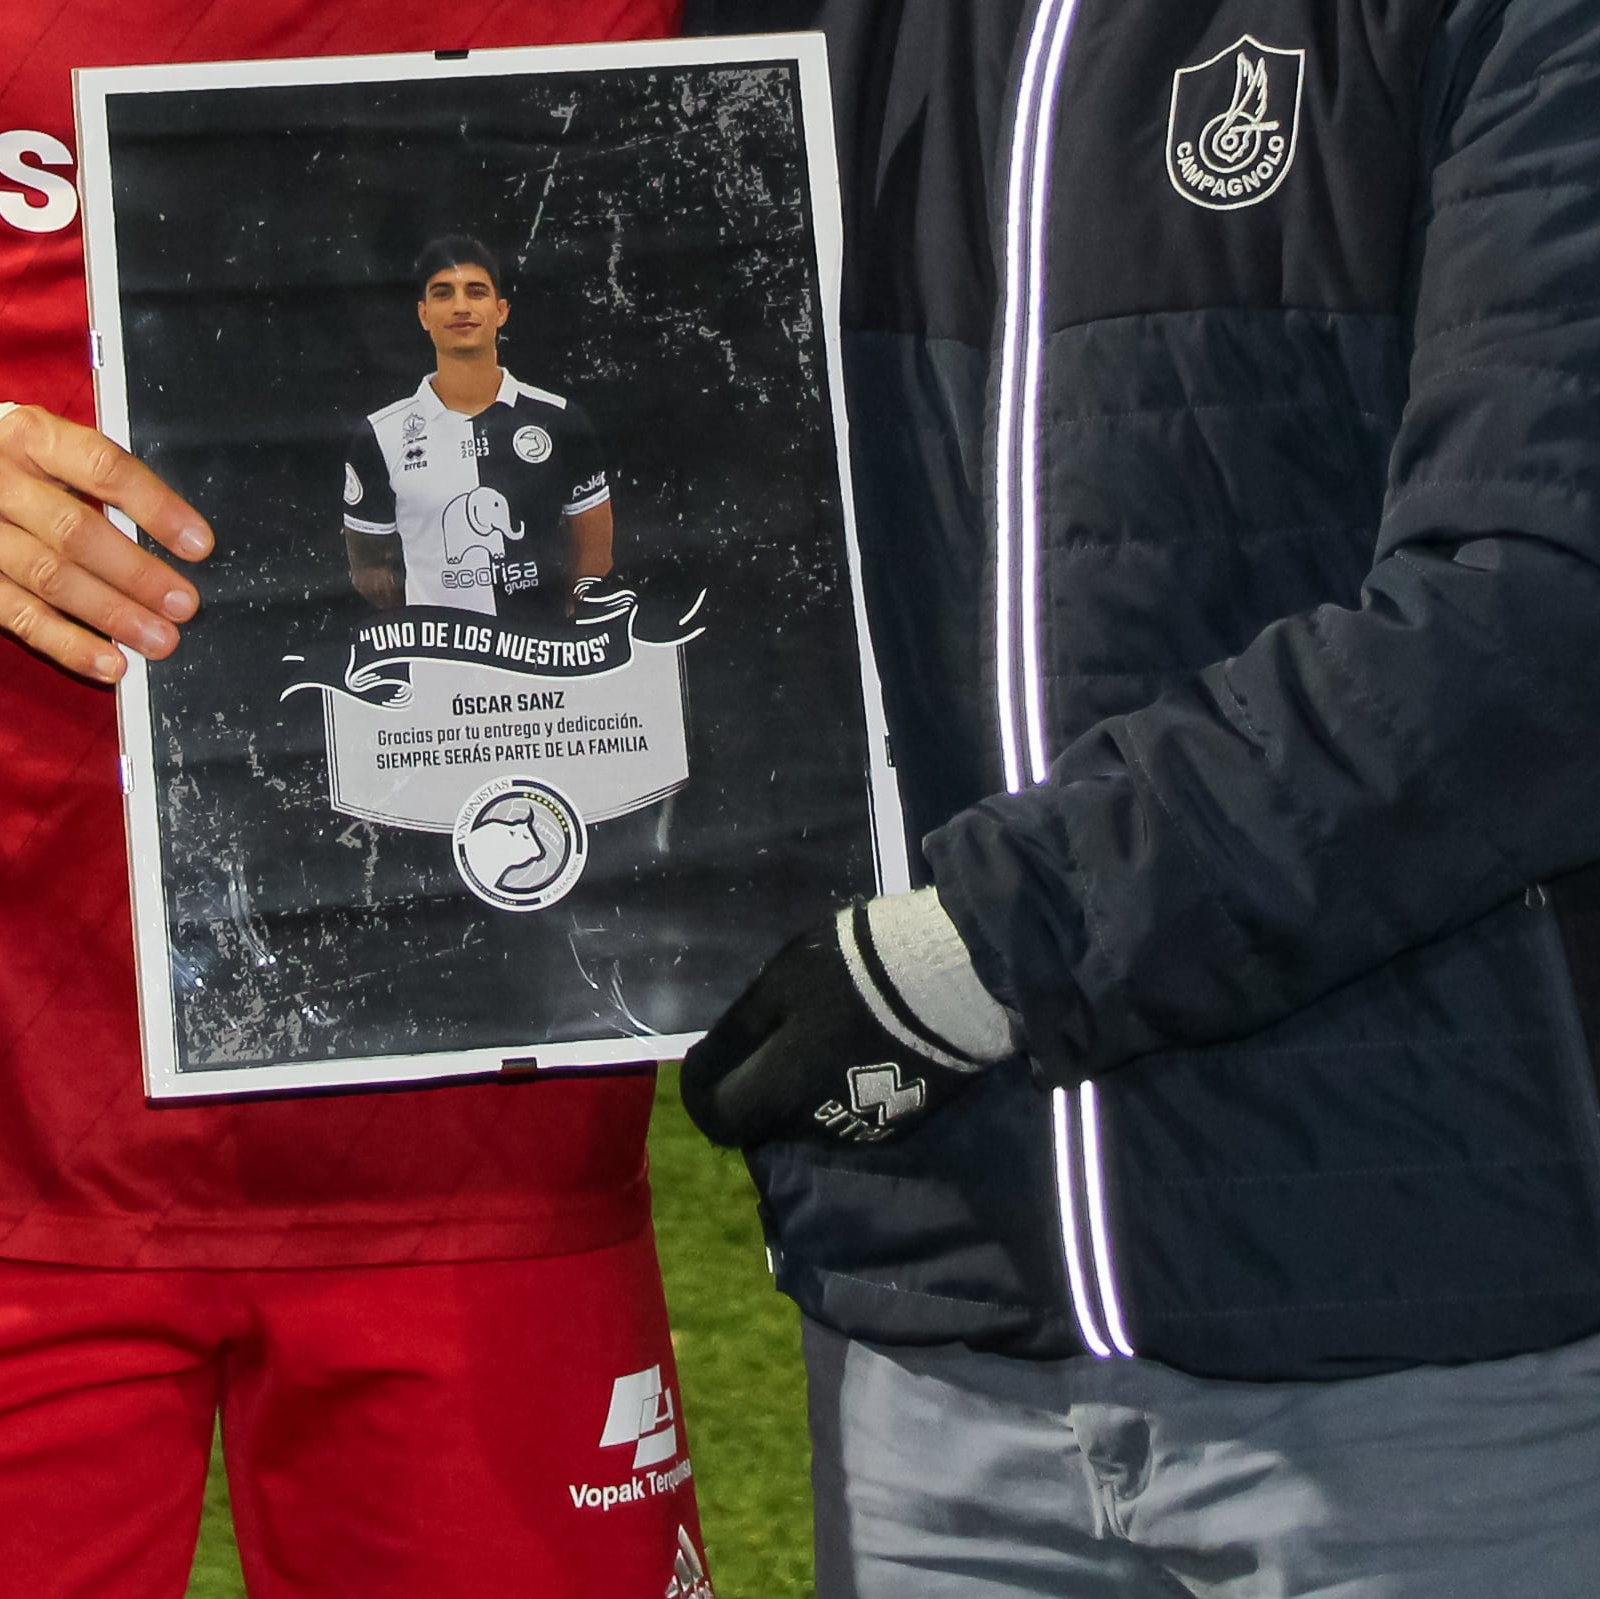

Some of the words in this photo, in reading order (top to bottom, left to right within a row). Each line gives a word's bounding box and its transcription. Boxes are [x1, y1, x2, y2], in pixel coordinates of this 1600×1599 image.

[1176, 135, 1285, 198] CAMPAGNOLO
[461, 437, 488, 450] 2013
[421, 622, 449, 650] DE
[454, 625, 493, 653] LOS
[452, 694, 513, 716] ÓSCAR
[518, 691, 565, 711] SANZ
[378, 730, 433, 746] Gracias
[437, 729, 461, 745] por
[465, 725, 480, 740] tu
[484, 722, 541, 741] entrega
[545, 721, 553, 738] y
[557, 712, 643, 735] dedicación.
[376, 750, 441, 770] SIEMPRE
[444, 743, 492, 765] SERÁS
[495, 743, 541, 762] PARTE
[546, 742, 563, 758] DE
[567, 740, 585, 757] LA
[589, 735, 648, 755] FAMILIA
[569, 1476, 646, 1512] Vopak
